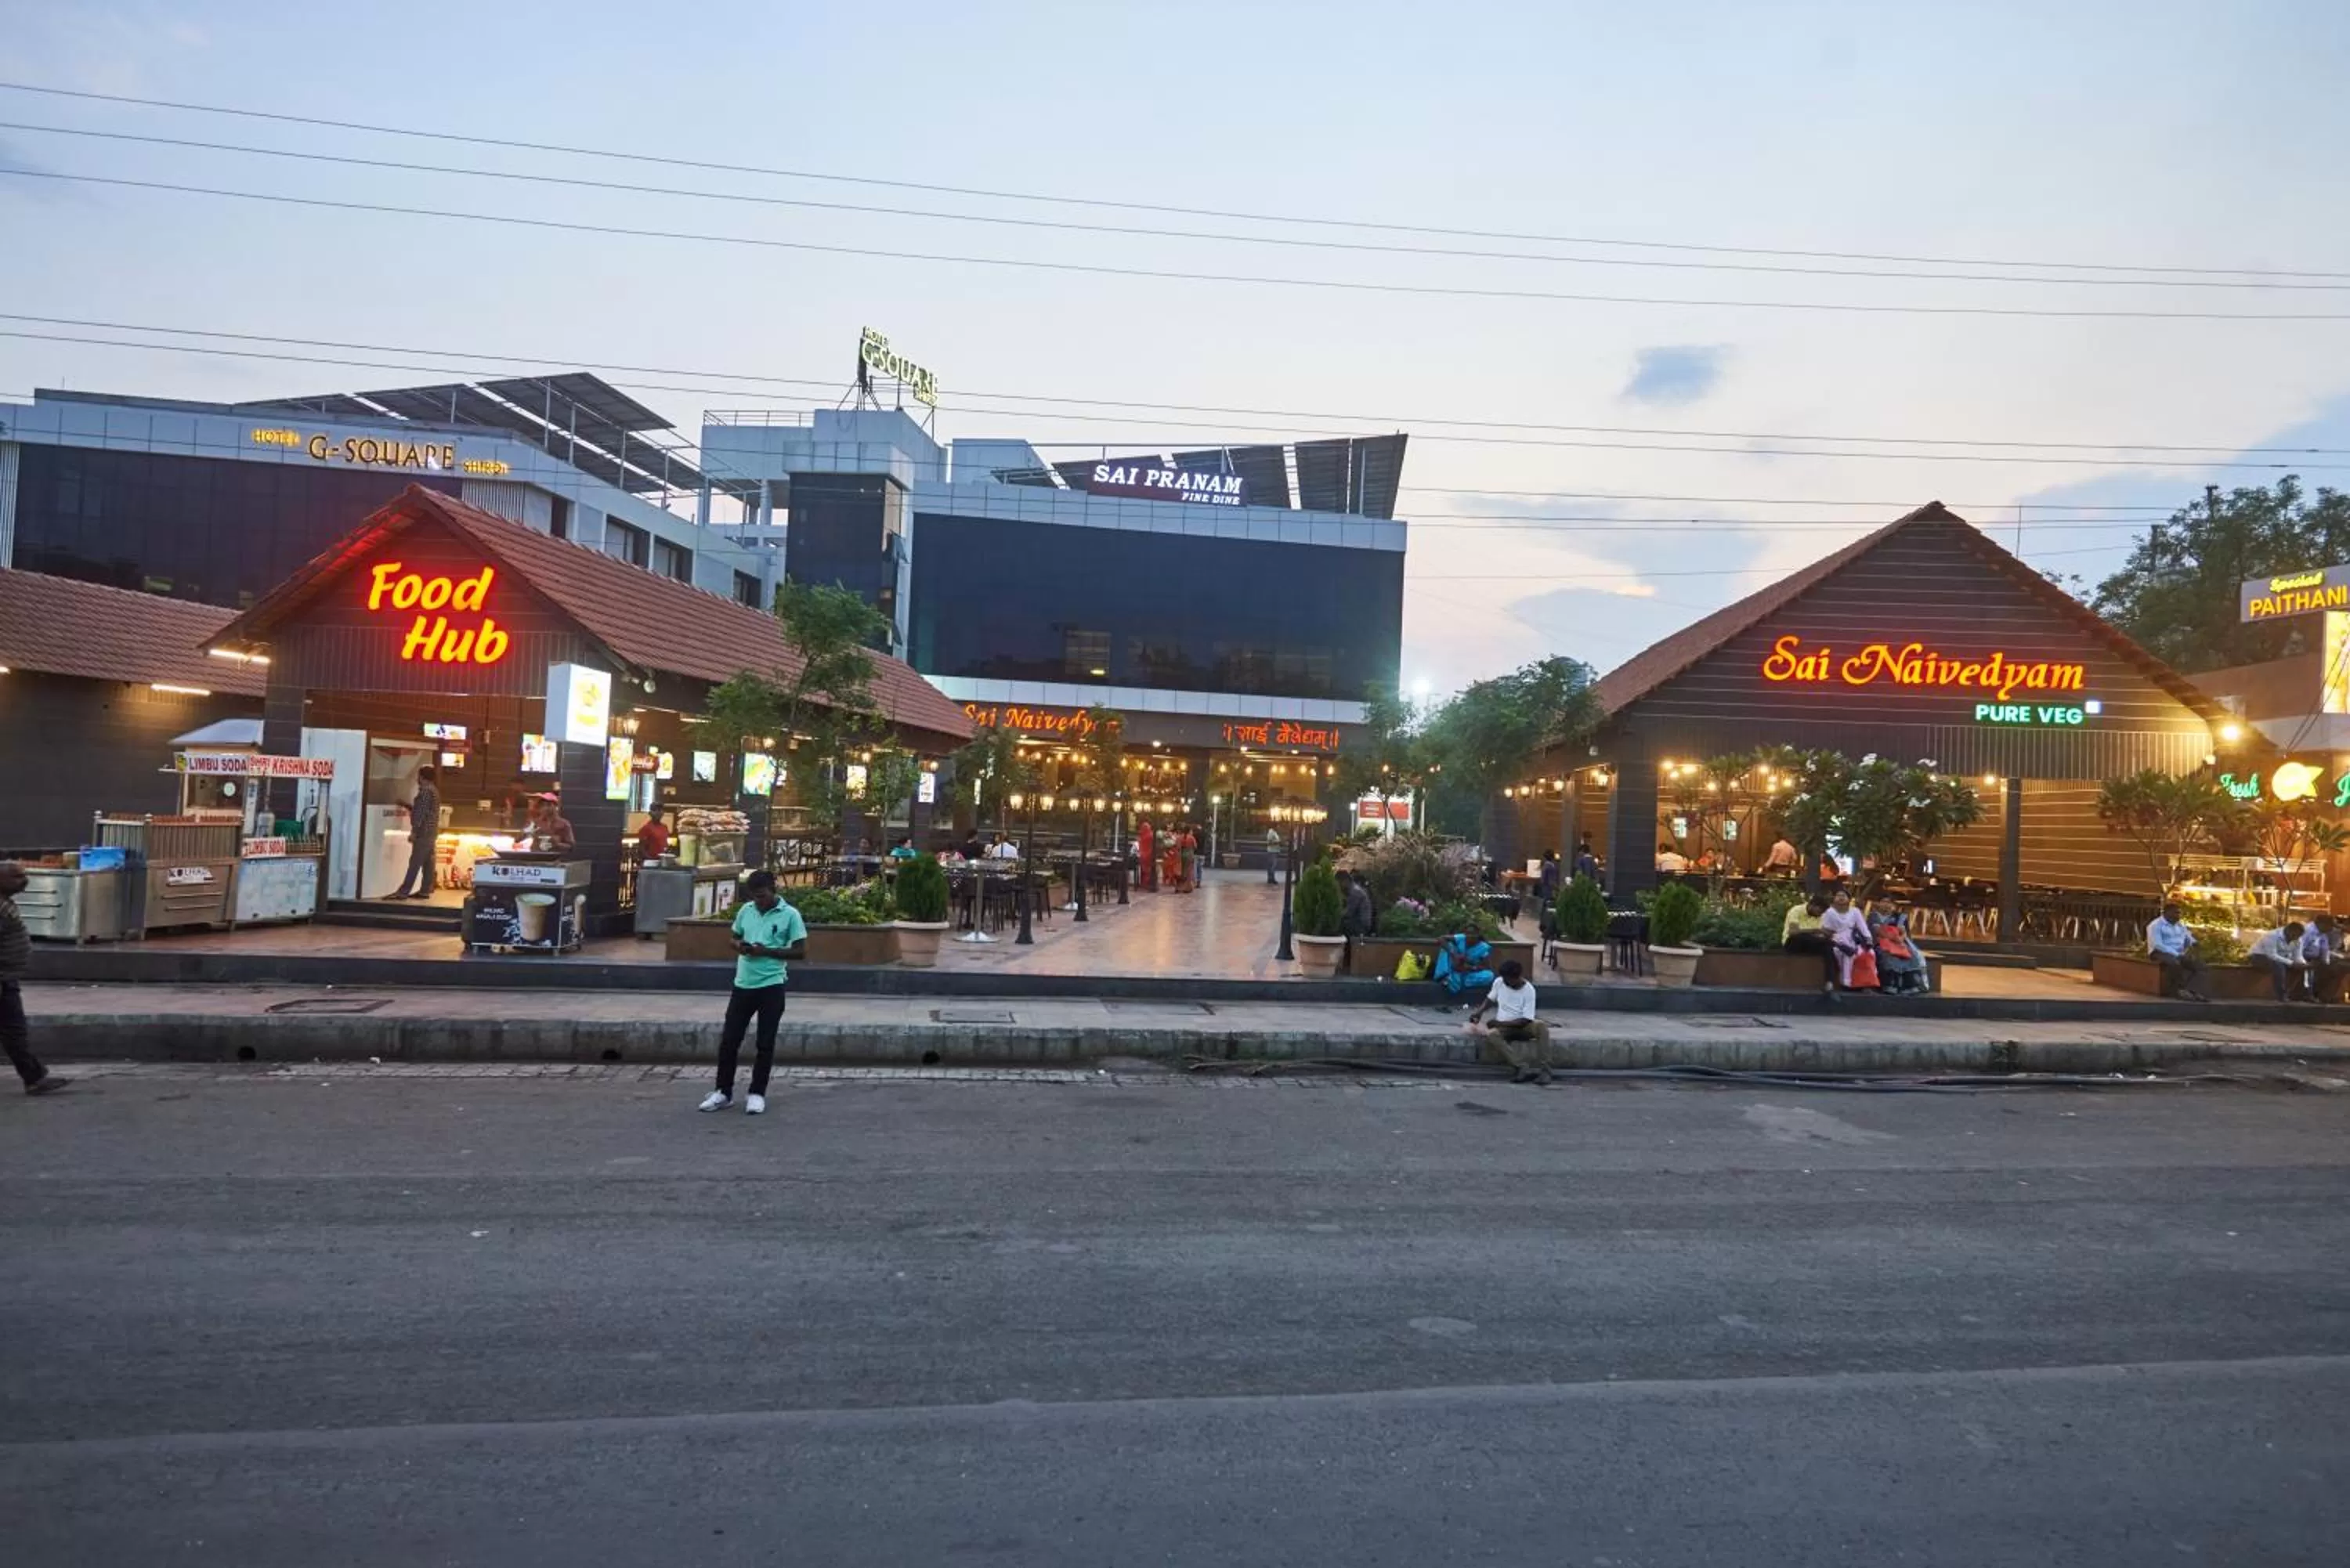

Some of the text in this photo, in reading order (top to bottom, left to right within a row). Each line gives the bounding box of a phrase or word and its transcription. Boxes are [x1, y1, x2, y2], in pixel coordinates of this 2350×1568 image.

[862, 340, 938, 394] G-SQUARE
[309, 436, 455, 470] G-SQUARE
[1094, 465, 1243, 494] SAI PRANAM
[1181, 491, 1241, 505] FINE DINE
[368, 562, 494, 611] Food
[2249, 584, 2348, 617] PAITHANI
[401, 615, 508, 664] Hub
[1763, 636, 2084, 700] Sai Naivedyam
[965, 704, 1119, 737] Sai Naivedy
[1976, 704, 2084, 724] PURE VEG
[189, 757, 219, 771] LIMBU
[222, 759, 248, 771] SODA
[273, 758, 309, 775] KRISHNA
[313, 759, 334, 776] SODA
[2220, 773, 2260, 797] Fresh
